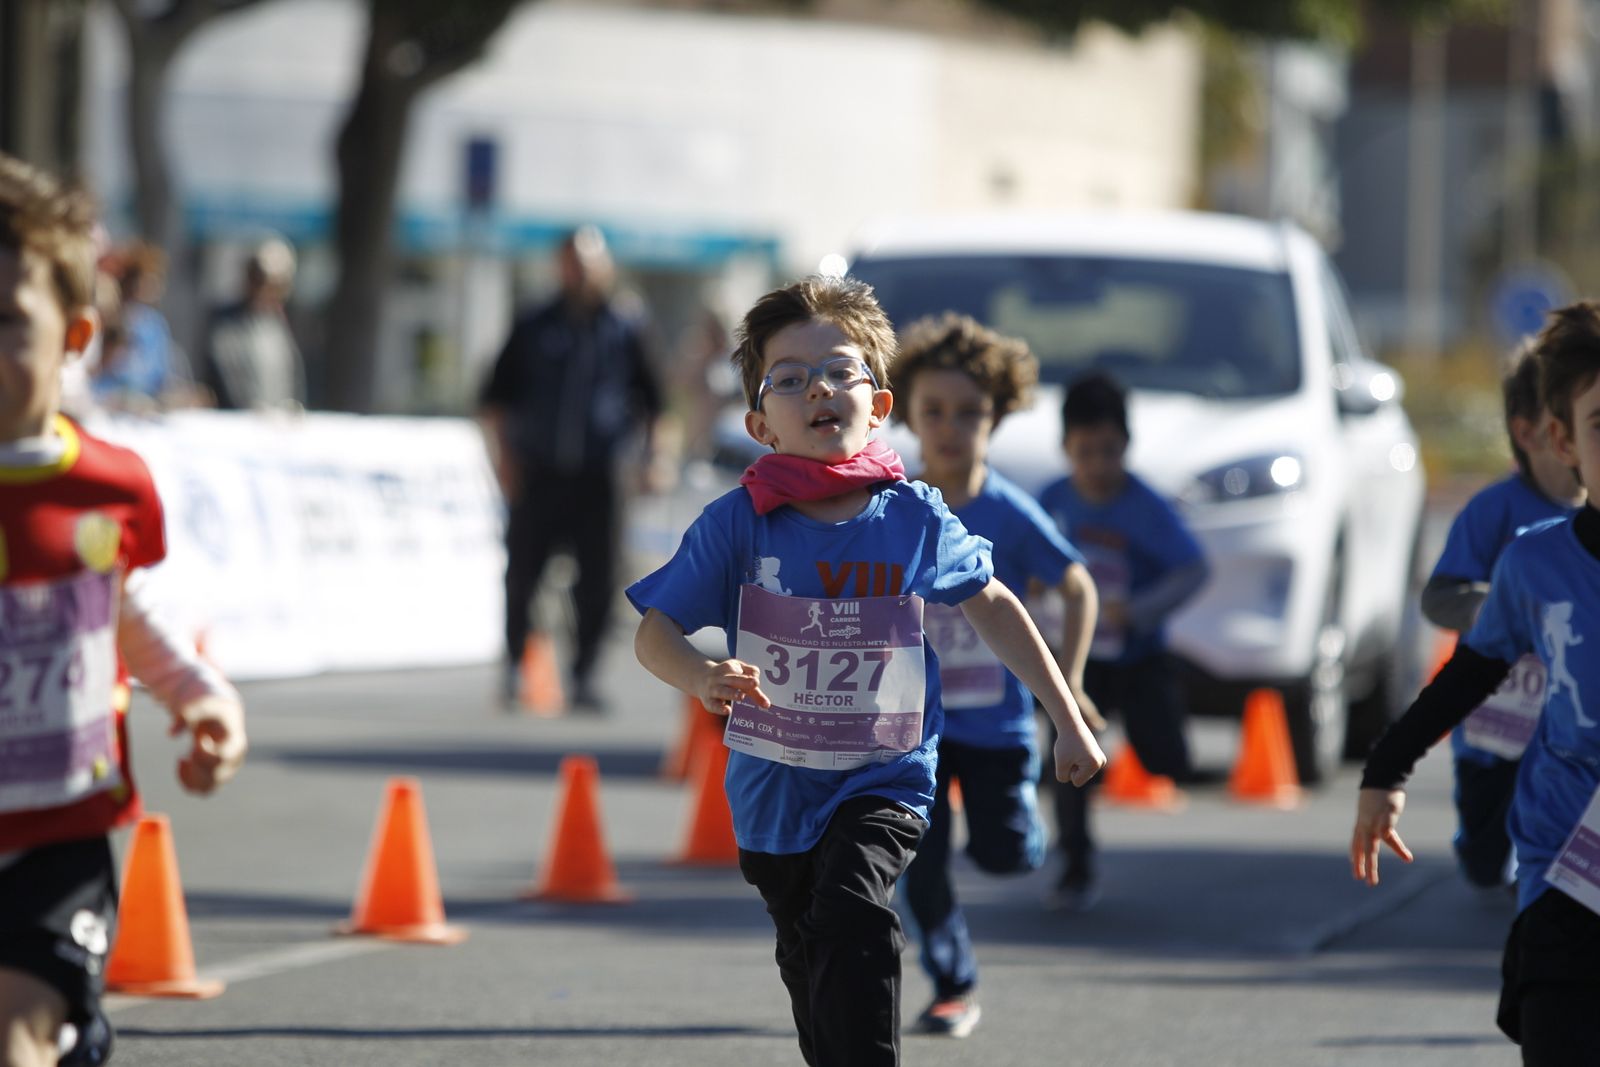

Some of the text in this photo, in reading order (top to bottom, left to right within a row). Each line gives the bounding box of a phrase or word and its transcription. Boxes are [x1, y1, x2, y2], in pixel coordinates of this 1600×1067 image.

[816, 560, 904, 598] VIII
[831, 602, 860, 615] VIII
[779, 636, 819, 646] IGUALDAD
[764, 644, 893, 691] 3127
[793, 692, 854, 706] HÉCTOR
[732, 717, 755, 730] NEXA
